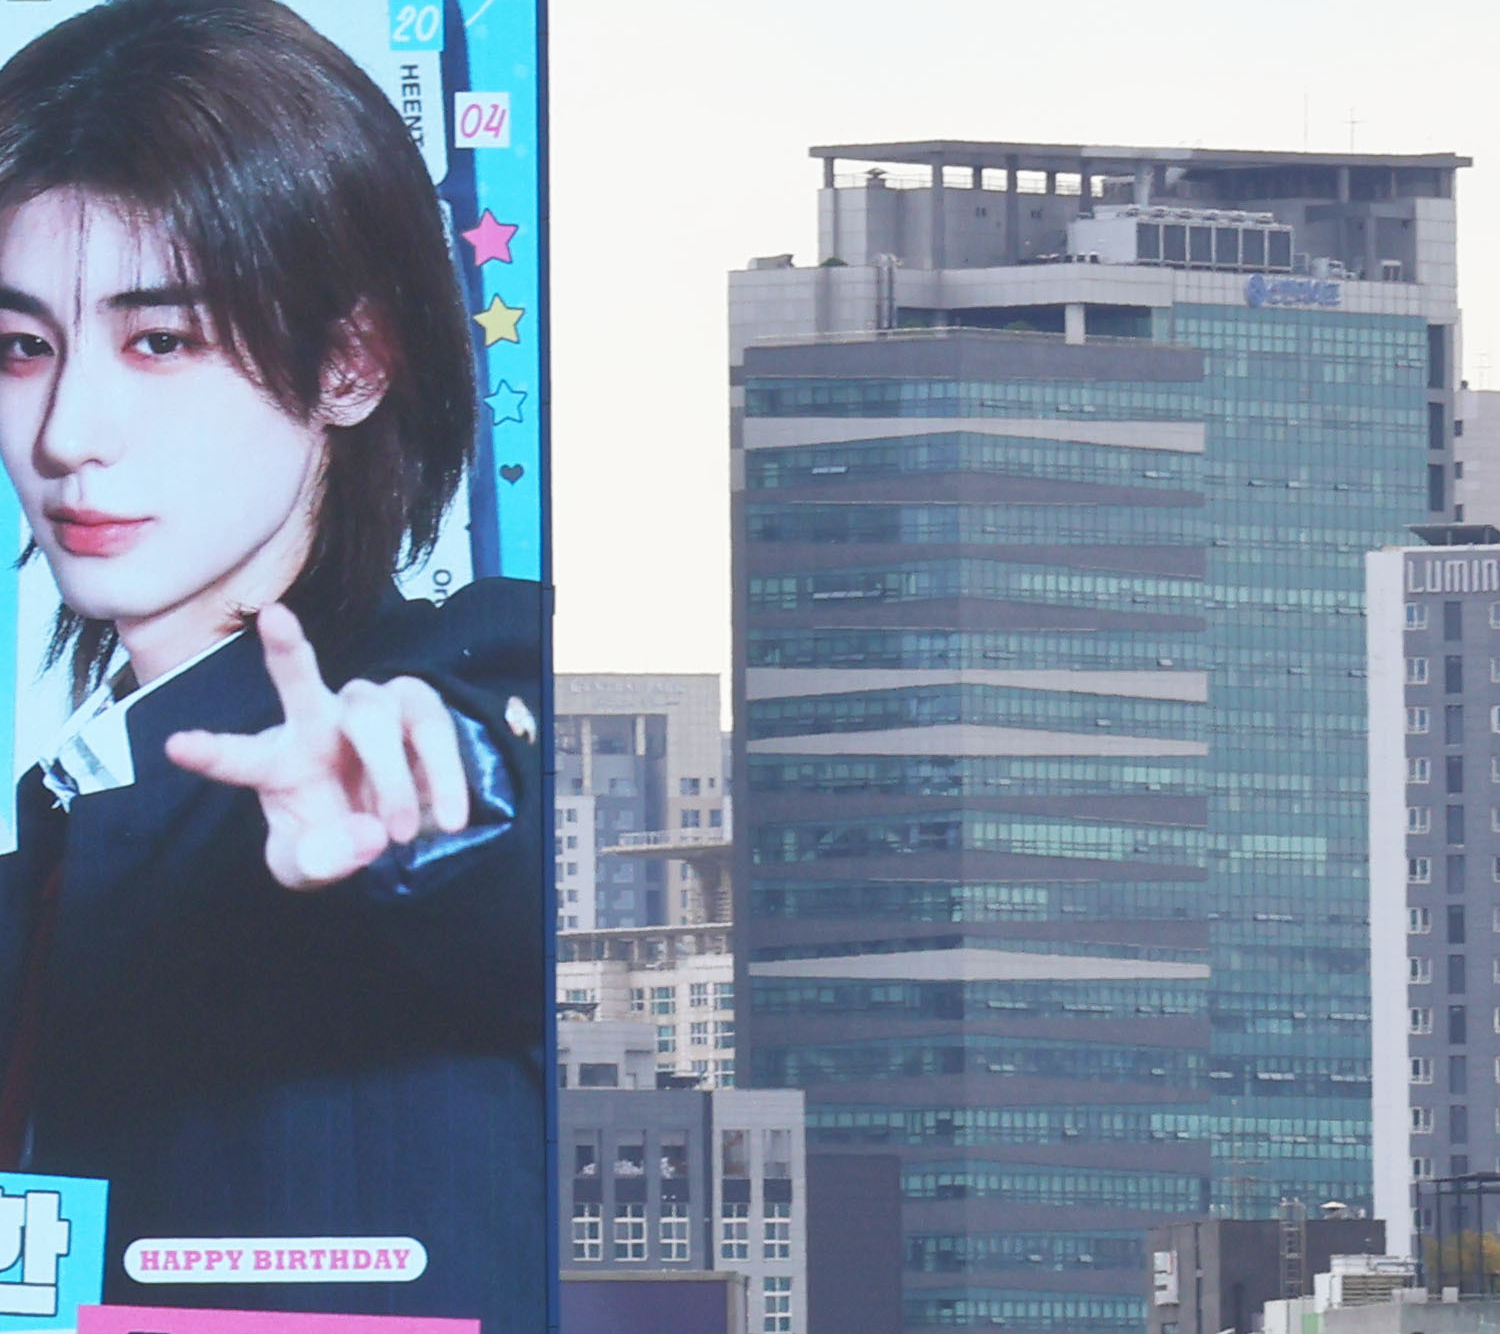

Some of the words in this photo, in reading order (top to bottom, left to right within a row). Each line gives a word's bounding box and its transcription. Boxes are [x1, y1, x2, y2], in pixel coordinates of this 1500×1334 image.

[393, 4, 441, 43] 20
[460, 104, 507, 139] 04
[140, 1250, 243, 1272] HAPPY
[252, 1249, 411, 1271] BIRTHDAY
